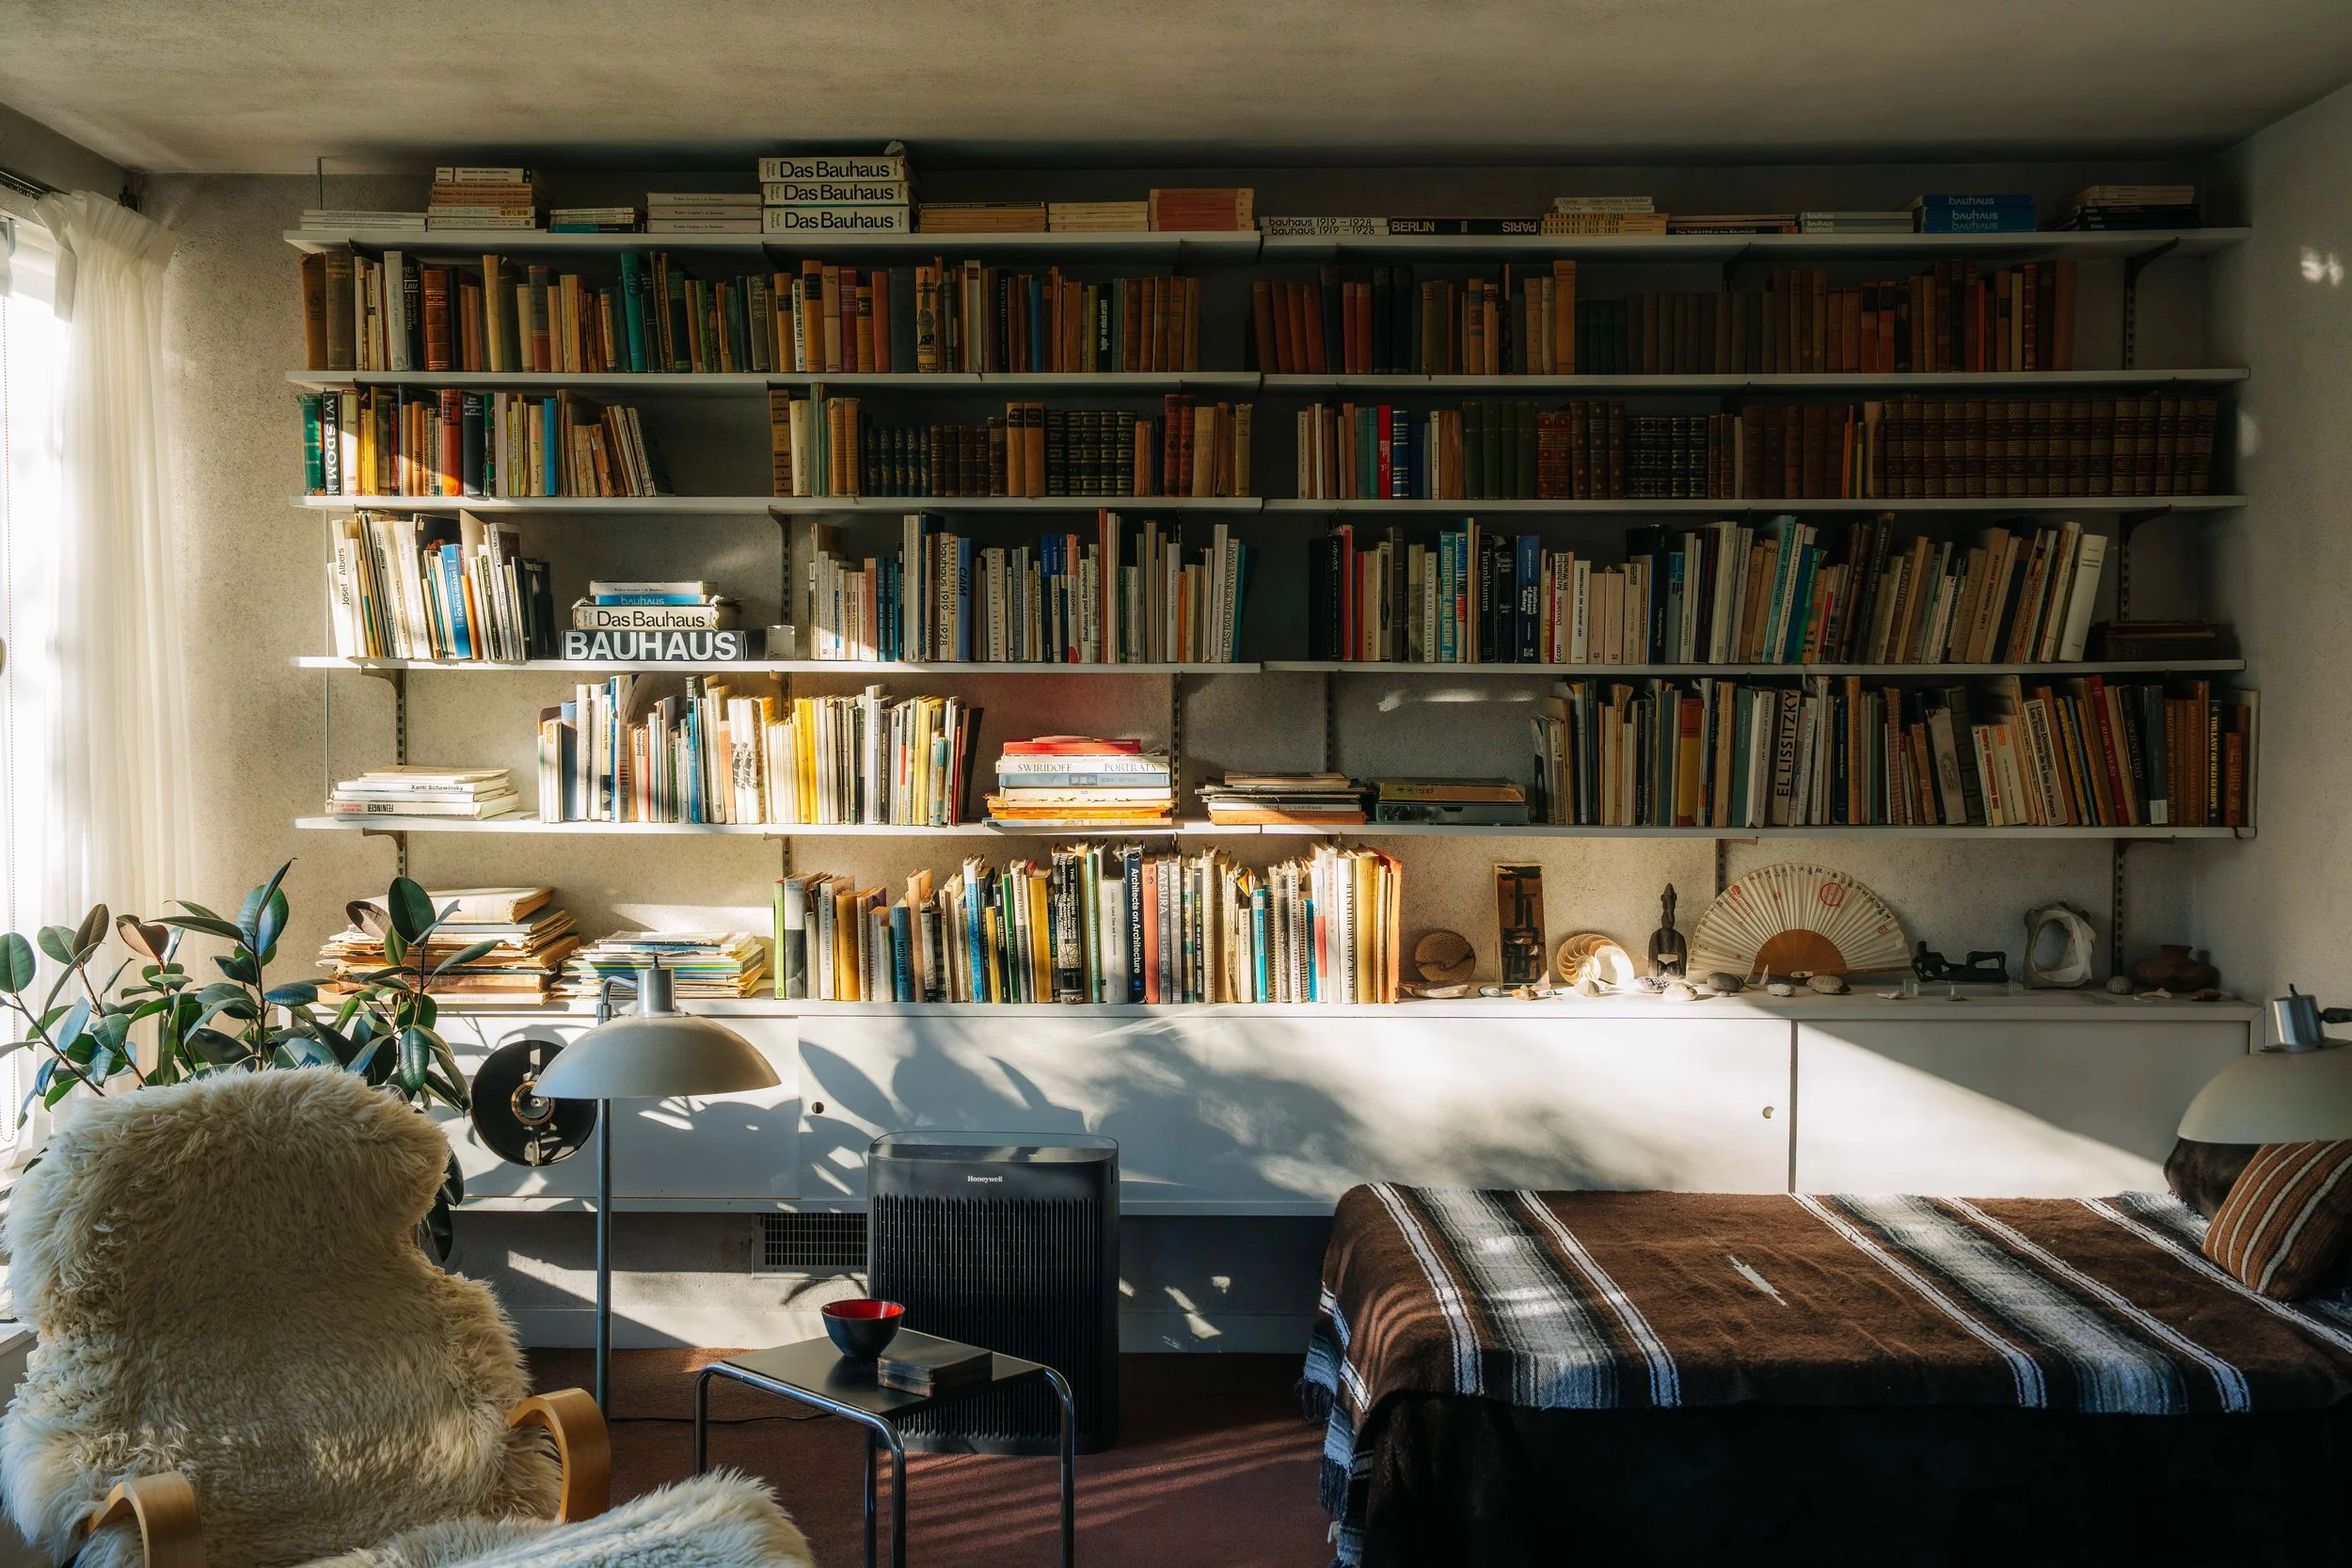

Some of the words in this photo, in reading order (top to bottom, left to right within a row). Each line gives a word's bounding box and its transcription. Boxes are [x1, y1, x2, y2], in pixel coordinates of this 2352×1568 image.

[779, 161, 815, 179] Das
[816, 160, 890, 178] Bauhaus
[784, 183, 818, 200] Das
[820, 183, 894, 200] Bauhaus
[1948, 196, 1994, 205] bauhaus
[785, 212, 818, 229] Das
[820, 211, 894, 229] Bauhaus
[1269, 217, 1312, 227] bauhaus
[1316, 217, 1336, 227] 1919
[1349, 217, 1372, 227] 1928
[1391, 221, 1436, 232] BERLIN
[1502, 221, 1537, 233] PARIS
[1950, 220, 1999, 231] bauhaus
[1951, 210, 1999, 220] bauhaus
[1271, 226, 1315, 235] bauhaus
[1319, 226, 1339, 235] 1919
[1353, 226, 1375, 235] 1928
[326, 397, 337, 480] WISDOM
[637, 442, 647, 474] CONFUCIUS
[1779, 523, 1792, 562] Landscape
[337, 547, 346, 576] Albers
[940, 543, 949, 587] bauhaus
[1226, 546, 1235, 581] WEIMAR
[1457, 536, 1467, 580] COMMUNITY
[959, 566, 968, 597] CIAM
[1226, 581, 1233, 590] IN
[1443, 546, 1453, 601] ARCHITECTURE
[1457, 579, 1467, 594] AND
[1482, 547, 1491, 612] Tutankhamen
[1774, 563, 1787, 607] Architecture
[1896, 562, 1911, 611] PLANNING
[340, 583, 350, 607] Josef
[620, 594, 665, 605] bauhaus
[941, 591, 949, 610] 1919
[1443, 601, 1453, 617] AND
[1457, 594, 1467, 624] PRIVACY
[1983, 582, 1994, 611] MODERNE
[596, 610, 630, 627] Das
[632, 610, 706, 627] Bauhaus
[1224, 591, 1233, 630] BAUHAUS
[565, 631, 737, 660] BAUHAUS
[940, 624, 948, 646] 1928
[1443, 618, 1454, 647] ENERGY
[1769, 616, 1779, 647] Simonds
[1778, 690, 1798, 773] LISSITZKY
[2036, 705, 2045, 732] Lorenzo
[2125, 719, 2138, 753] ANCIENT
[2133, 758, 2144, 780] ITALY
[2210, 732, 2218, 752] LAST
[1017, 763, 1072, 772] SWIRIDOFF
[2030, 721, 2042, 754] Esculturas
[2039, 755, 2045, 764] de
[2047, 795, 2057, 818] Pascua
[2106, 750, 2116, 777] ESPAÑA
[2210, 752, 2217, 763] OF
[1776, 778, 1789, 797] EL
[2210, 779, 2218, 809] EUROPE
[367, 803, 394, 813] FEININGER
[1015, 870, 1024, 920] KONSTRUKTIONEN
[1131, 867, 1139, 911] Architects
[1158, 865, 1168, 914] KATSURA
[1172, 865, 1181, 918] KATSURA
[1133, 911, 1138, 923] on
[897, 941, 908, 975] MODULOR
[1133, 923, 1141, 974] Architecture
[967, 1175, 1003, 1183] Honeywell
